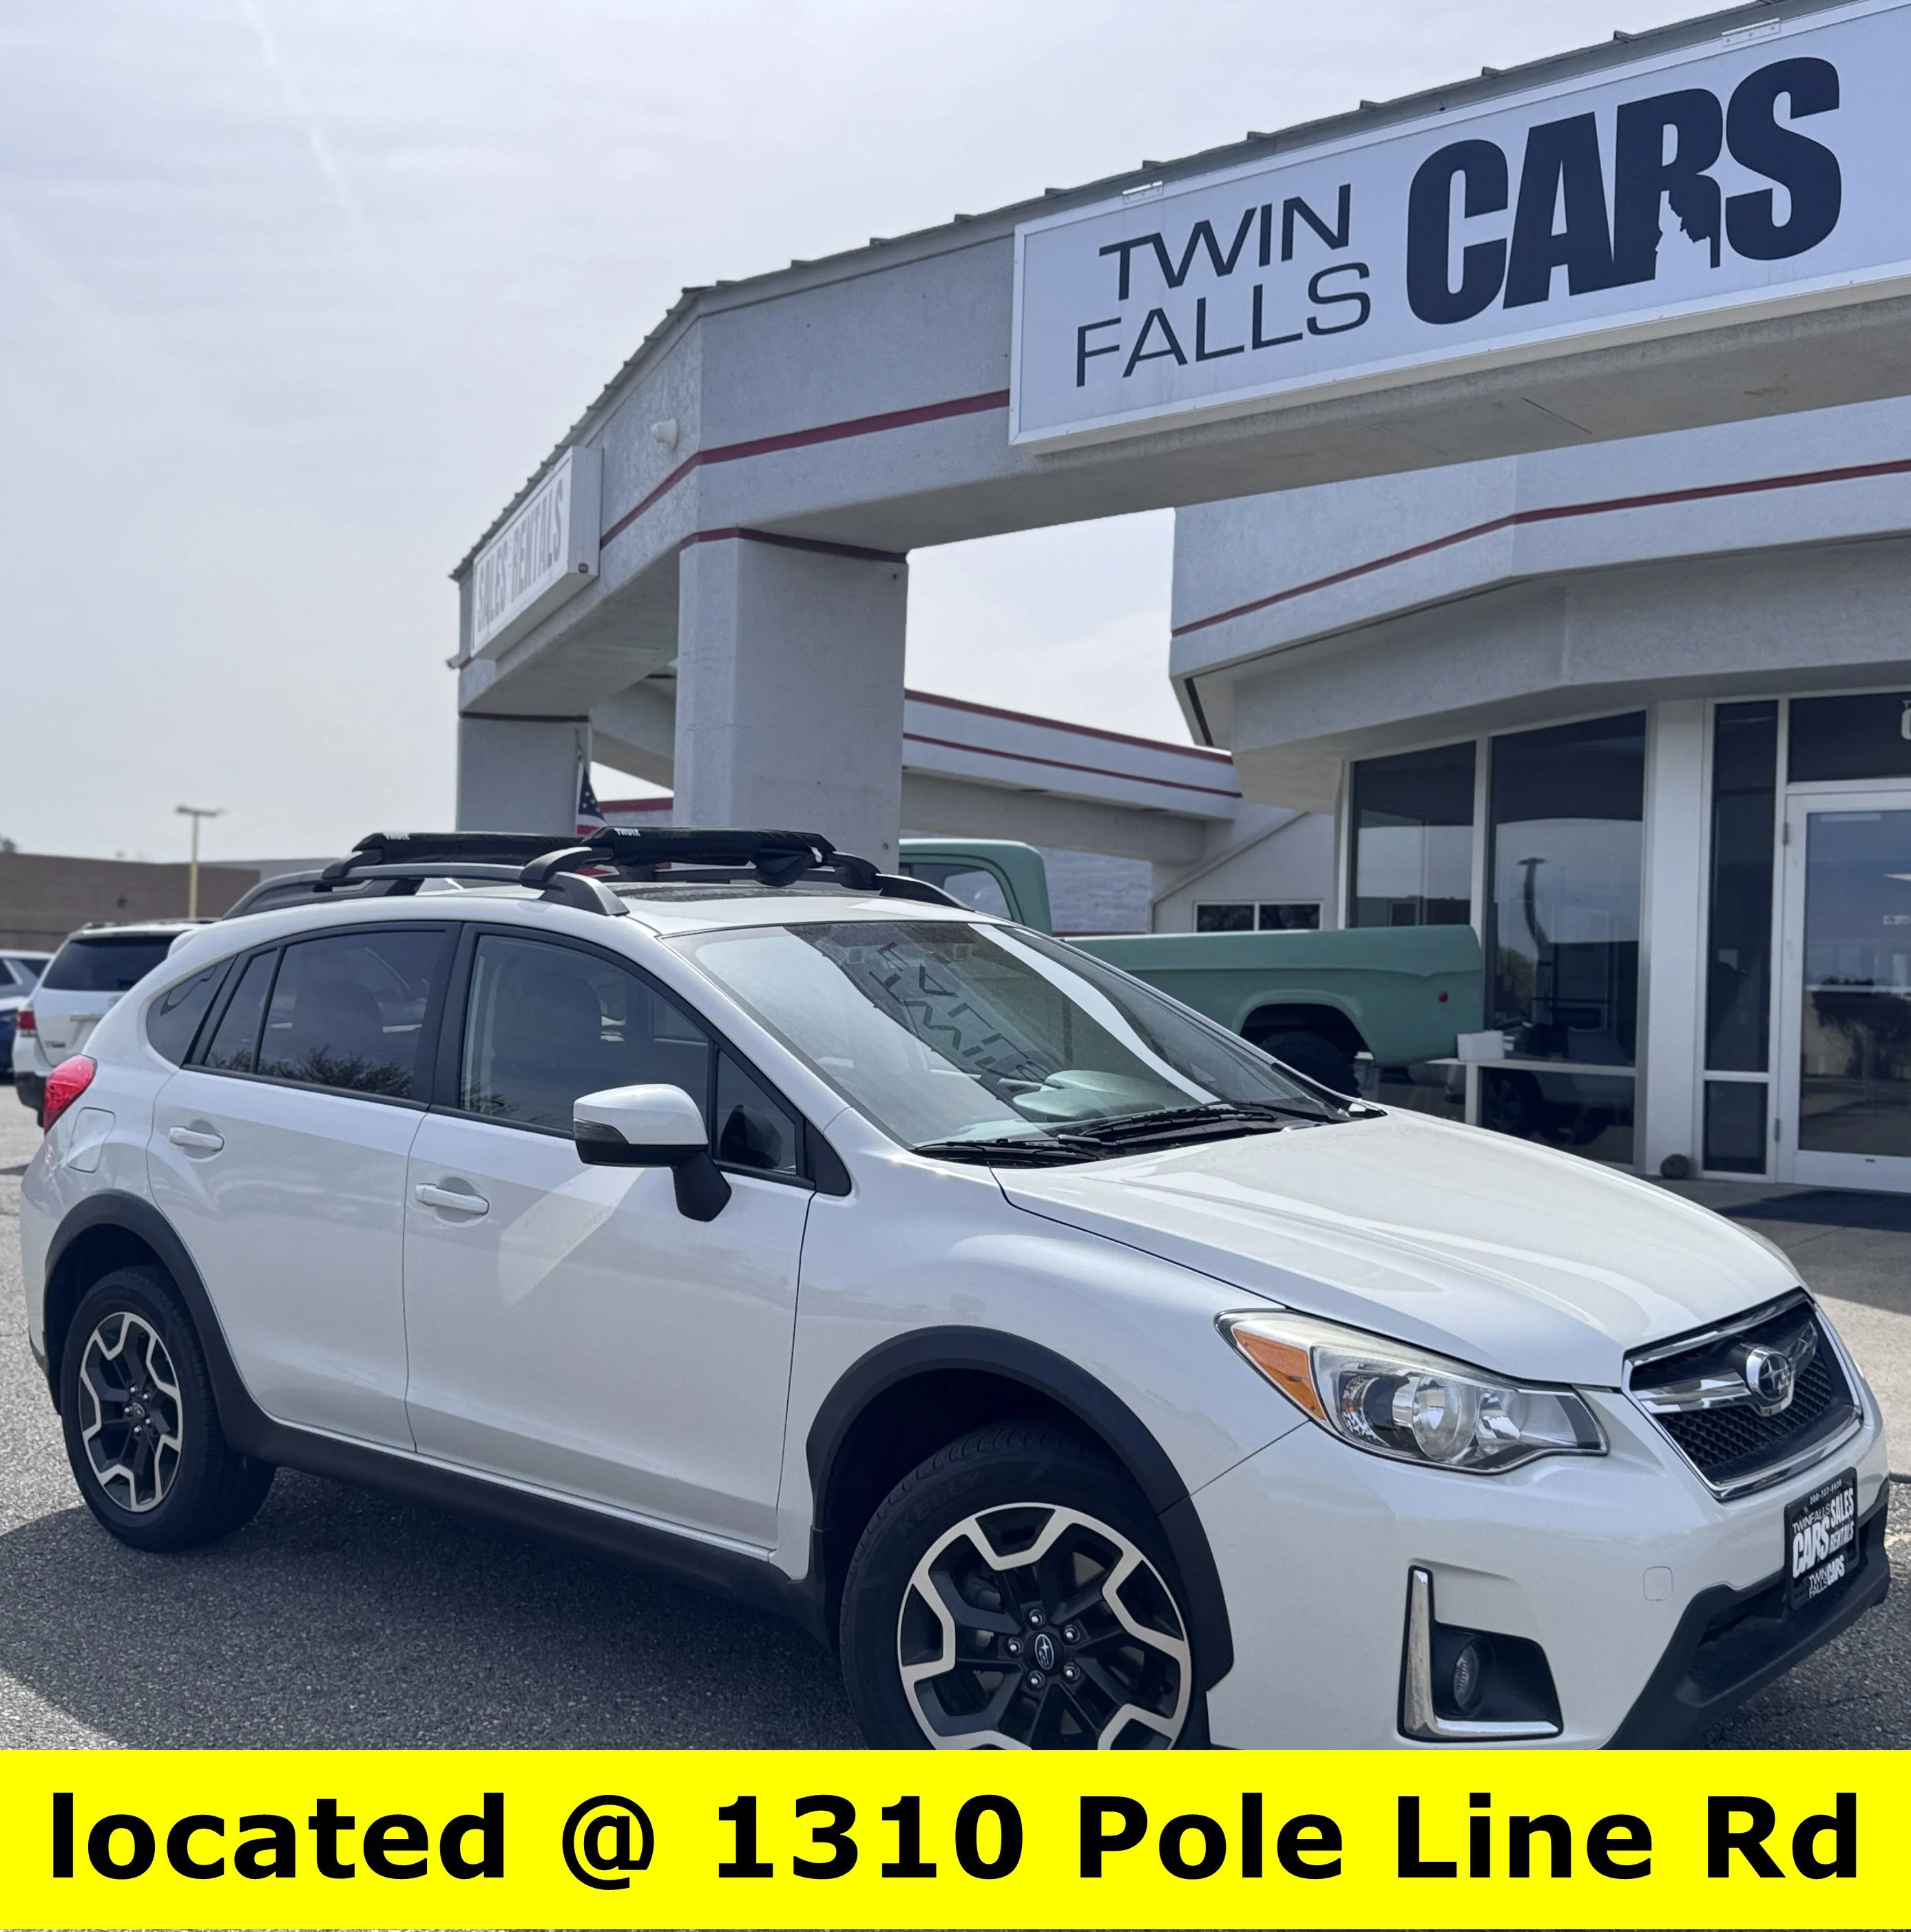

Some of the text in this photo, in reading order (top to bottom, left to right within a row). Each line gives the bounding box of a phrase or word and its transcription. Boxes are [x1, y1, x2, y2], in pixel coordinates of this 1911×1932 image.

[1407, 57, 1841, 324] CARS
[1099, 184, 1350, 300] TWIN
[1077, 263, 1370, 387] FALLS
[477, 479, 563, 634] SALES RENTALS
[614, 828, 641, 837] THULE
[1793, 1516, 1830, 1579] CARS
[1829, 1520, 1854, 1555] RENTALS
[1830, 1487, 1854, 1528] SALES
